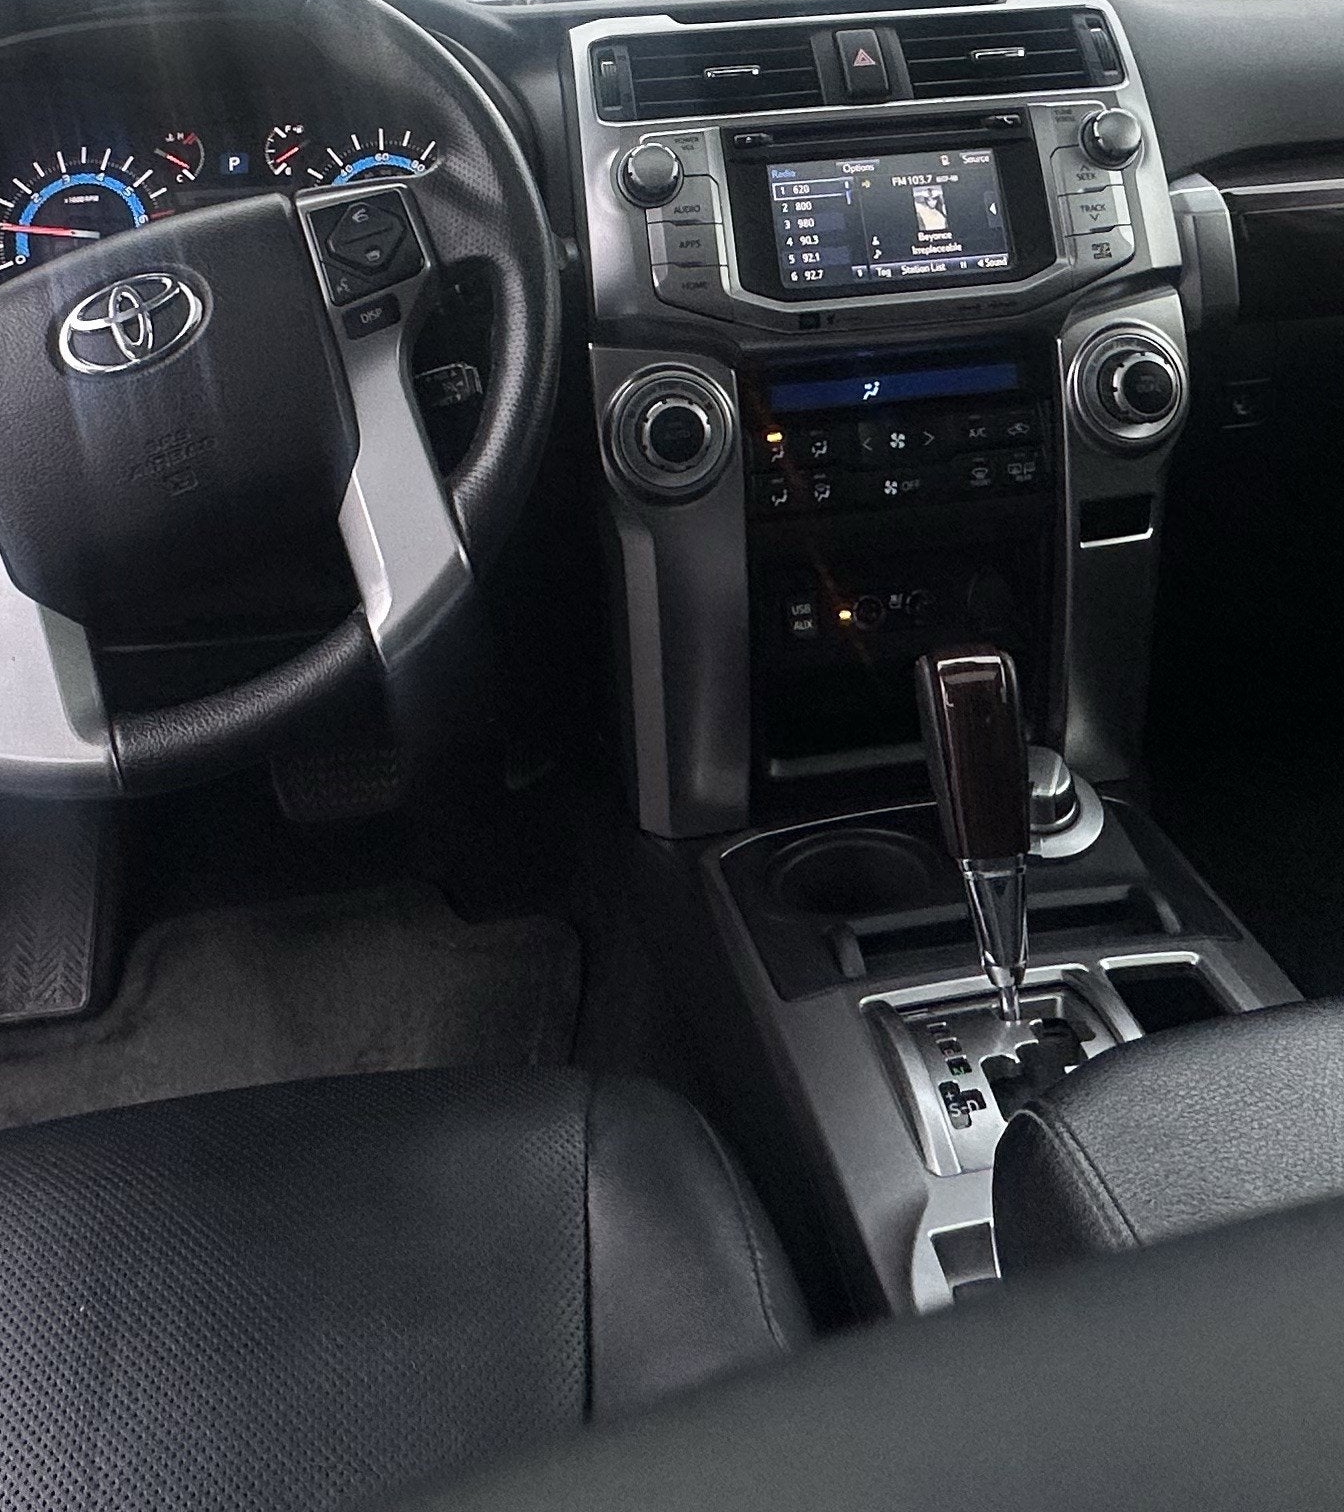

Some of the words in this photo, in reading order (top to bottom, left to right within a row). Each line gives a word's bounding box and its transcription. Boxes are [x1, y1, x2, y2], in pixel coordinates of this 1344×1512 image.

[374, 152, 390, 162] 60
[962, 154, 990, 164] Source
[228, 156, 241, 172] P
[410, 159, 426, 172] 80
[842, 162, 875, 174] Options
[61, 173, 71, 185] 3
[95, 172, 106, 182] 4
[175, 174, 184, 184] C
[1076, 173, 1097, 181] SEEK
[792, 184, 810, 194] 620
[674, 204, 701, 213] AUDIO
[781, 202, 789, 213] 2
[794, 200, 813, 211] 800
[1080, 203, 1106, 212] TRACK
[783, 218, 791, 230] 3
[797, 217, 815, 228] 980
[679, 239, 701, 249] APPS
[785, 236, 794, 247] 4
[14, 254, 27, 266] 0
[787, 253, 796, 265] 5
[984, 255, 1008, 268] Sound
[877, 267, 892, 279] Tag
[901, 264, 930, 276] Station
[930, 261, 947, 273] List
[790, 270, 799, 282] 6
[682, 281, 708, 290] HOME
[360, 307, 384, 324] DISP
[791, 603, 812, 616] USB
[793, 619, 813, 631] AUX
